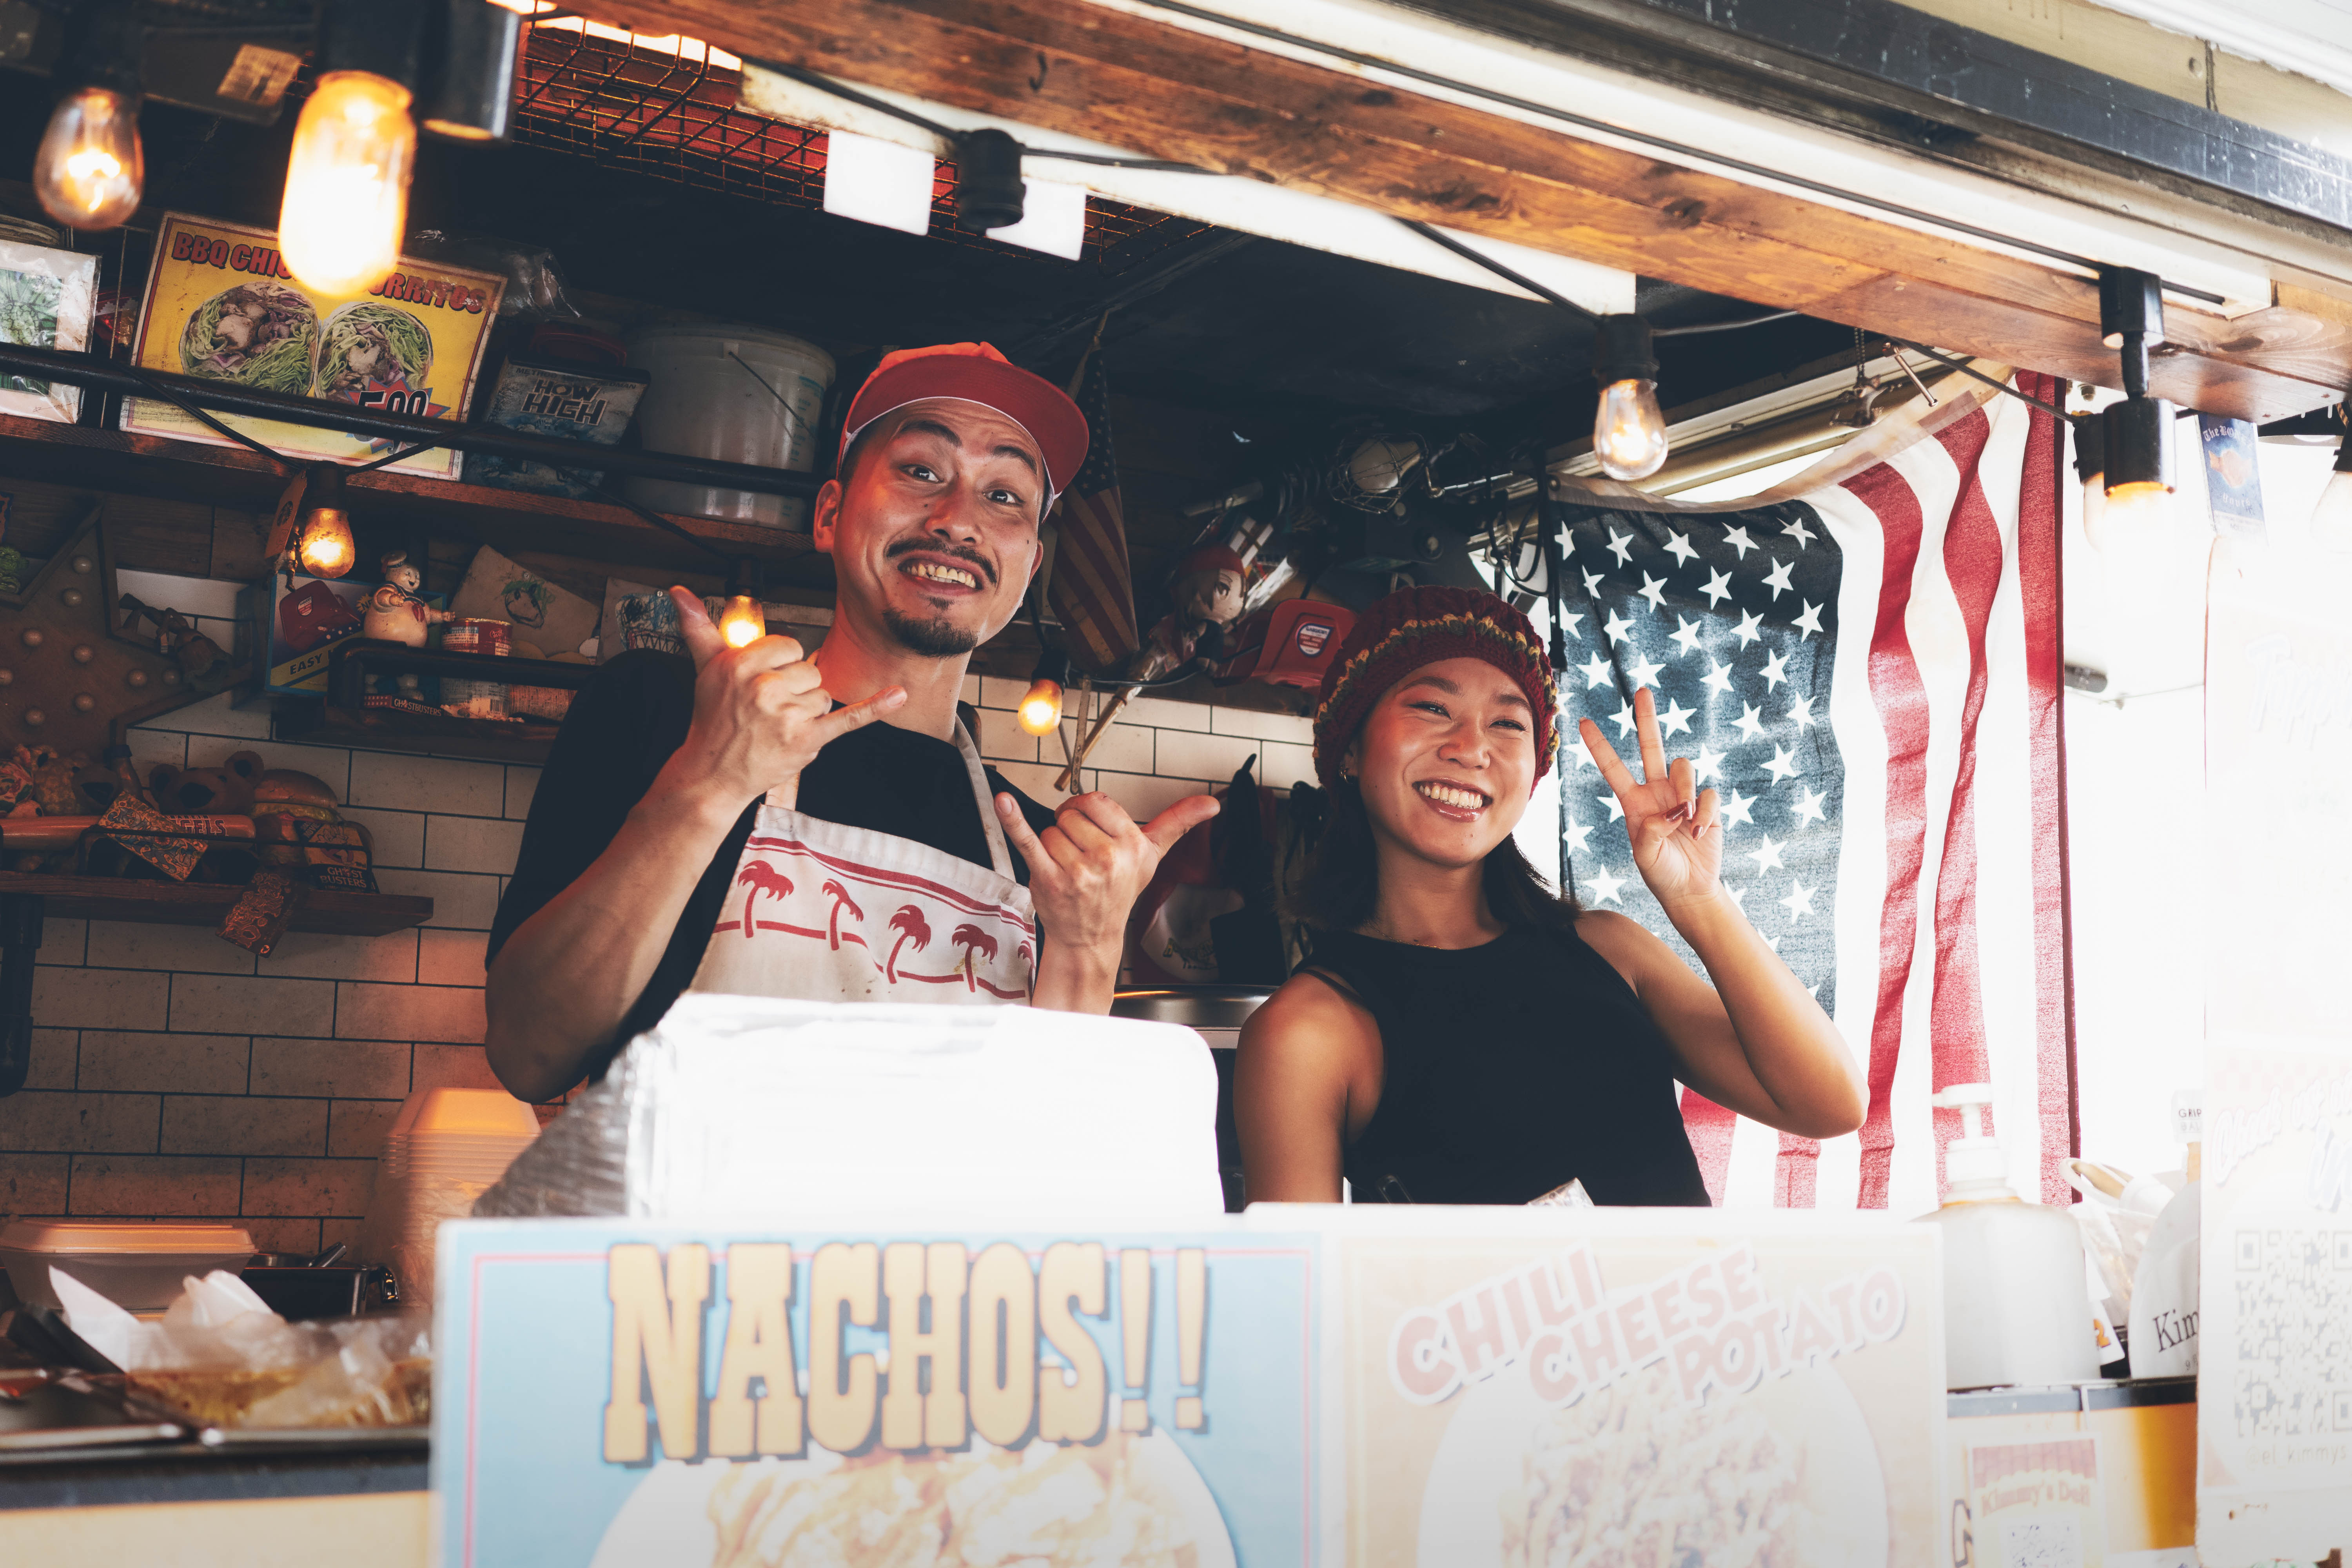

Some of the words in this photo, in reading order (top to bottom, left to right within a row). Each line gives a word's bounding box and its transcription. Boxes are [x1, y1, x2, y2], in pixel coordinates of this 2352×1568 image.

[171, 232, 230, 269] BBQ
[230, 243, 292, 279] CHIC
[367, 272, 486, 314] URRITOS
[520, 392, 608, 426] HIGH
[533, 378, 603, 403] HOW
[2203, 428, 2220, 442] The
[289, 653, 323, 676] EASY
[319, 875, 367, 888] BUSTERS
[1394, 1246, 1601, 1399] CHILI
[1526, 1247, 1762, 1405] CHEESE
[1668, 1269, 1905, 1403] POTATO
[603, 1241, 1209, 1468] NACHOS!!
